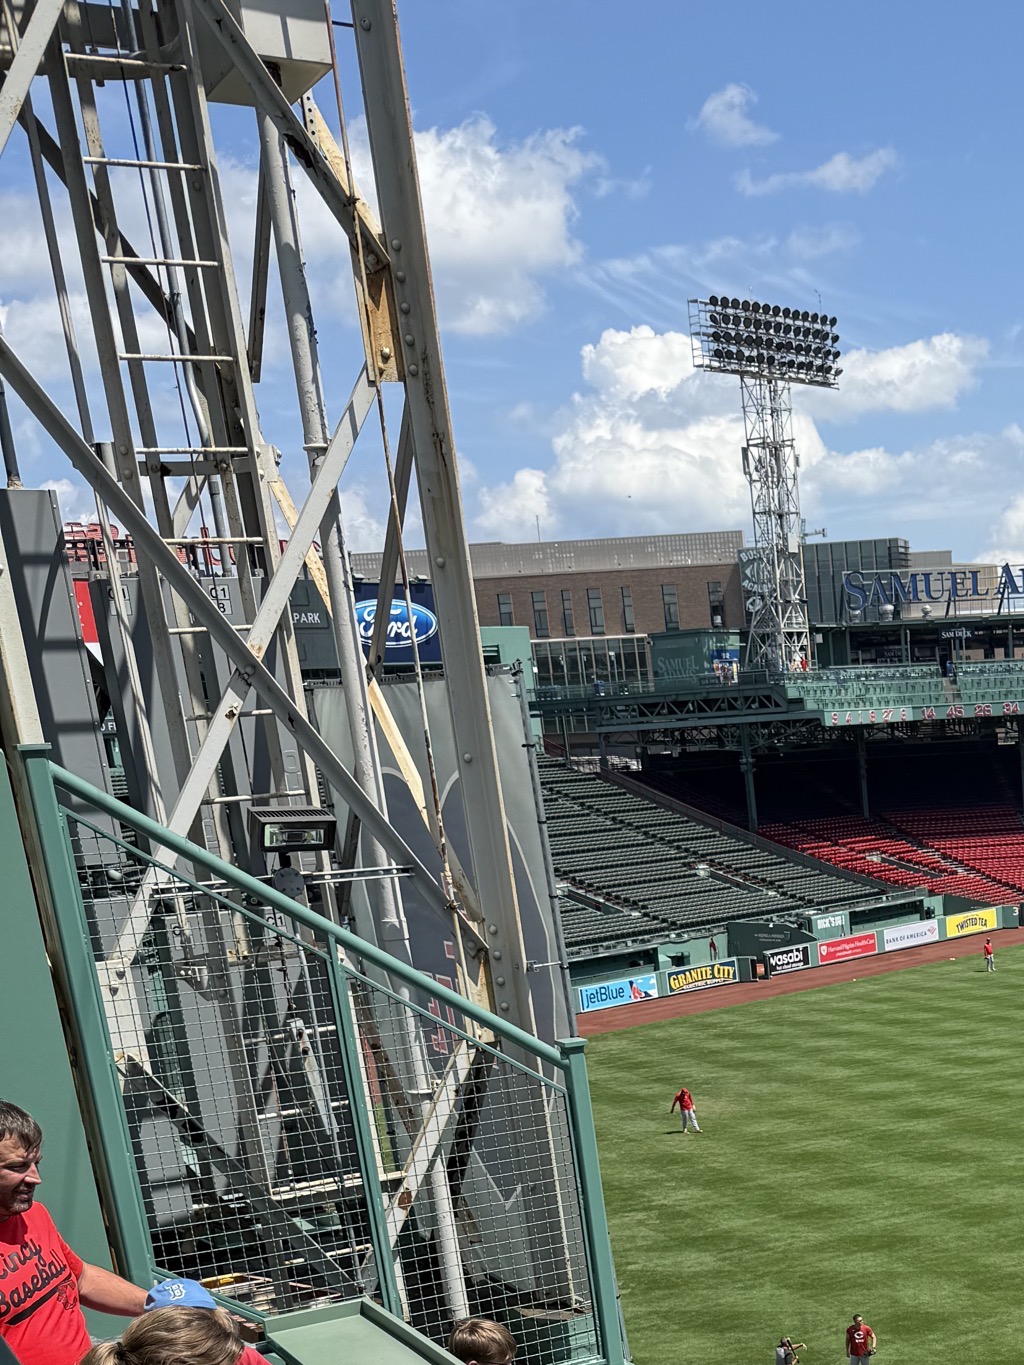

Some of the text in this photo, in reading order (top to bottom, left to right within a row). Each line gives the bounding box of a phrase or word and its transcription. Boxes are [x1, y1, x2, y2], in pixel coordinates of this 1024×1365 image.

[843, 570, 989, 611] SAMUEL
[658, 655, 700, 673] SAMUEL
[881, 708, 894, 723] 27
[921, 706, 936, 720] 14
[946, 704, 965, 719] 45
[956, 916, 988, 933] TWISTED TEA
[886, 936, 899, 944] BANK
[906, 930, 928, 940] AMERICA
[669, 963, 736, 989] GRANITE CITY
[585, 984, 625, 1009] jetBlue
